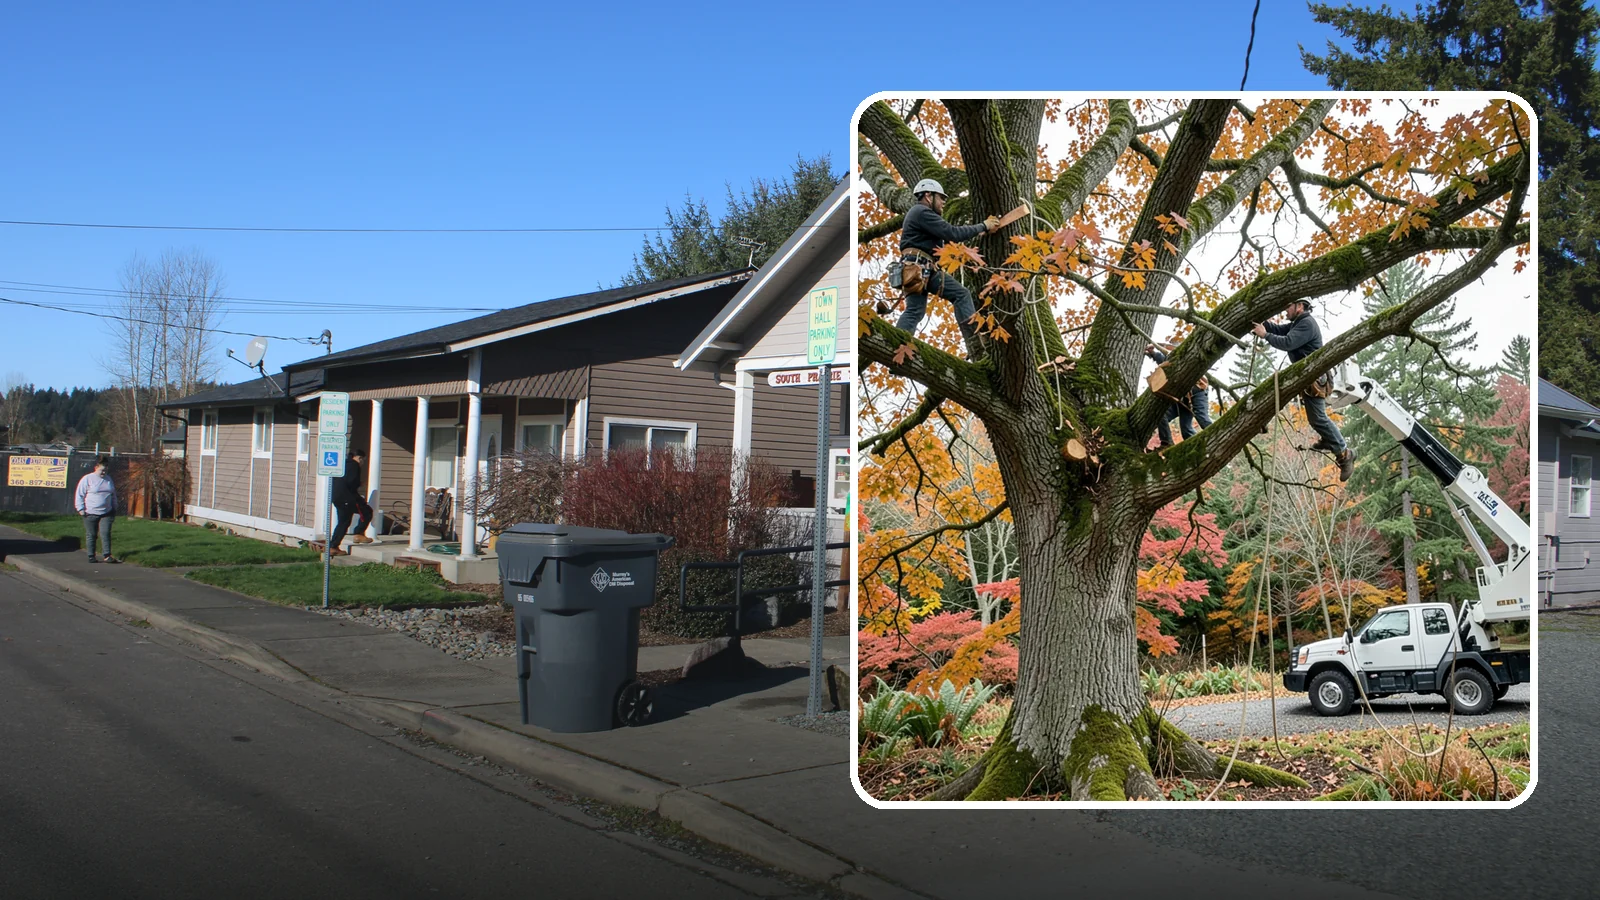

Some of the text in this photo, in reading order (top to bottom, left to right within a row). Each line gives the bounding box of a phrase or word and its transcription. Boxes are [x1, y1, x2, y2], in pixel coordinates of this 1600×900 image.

[815, 294, 833, 308] TOWN
[814, 311, 831, 324] HALL
[810, 326, 836, 340] PARKING
[813, 343, 831, 357] ONLY
[775, 370, 842, 384] SOUTH PRIE
[323, 409, 345, 417] PARKING
[325, 420, 340, 428] ONLY
[320, 436, 343, 444] RESERVED
[10, 479, 65, 488] 360-897-8625
